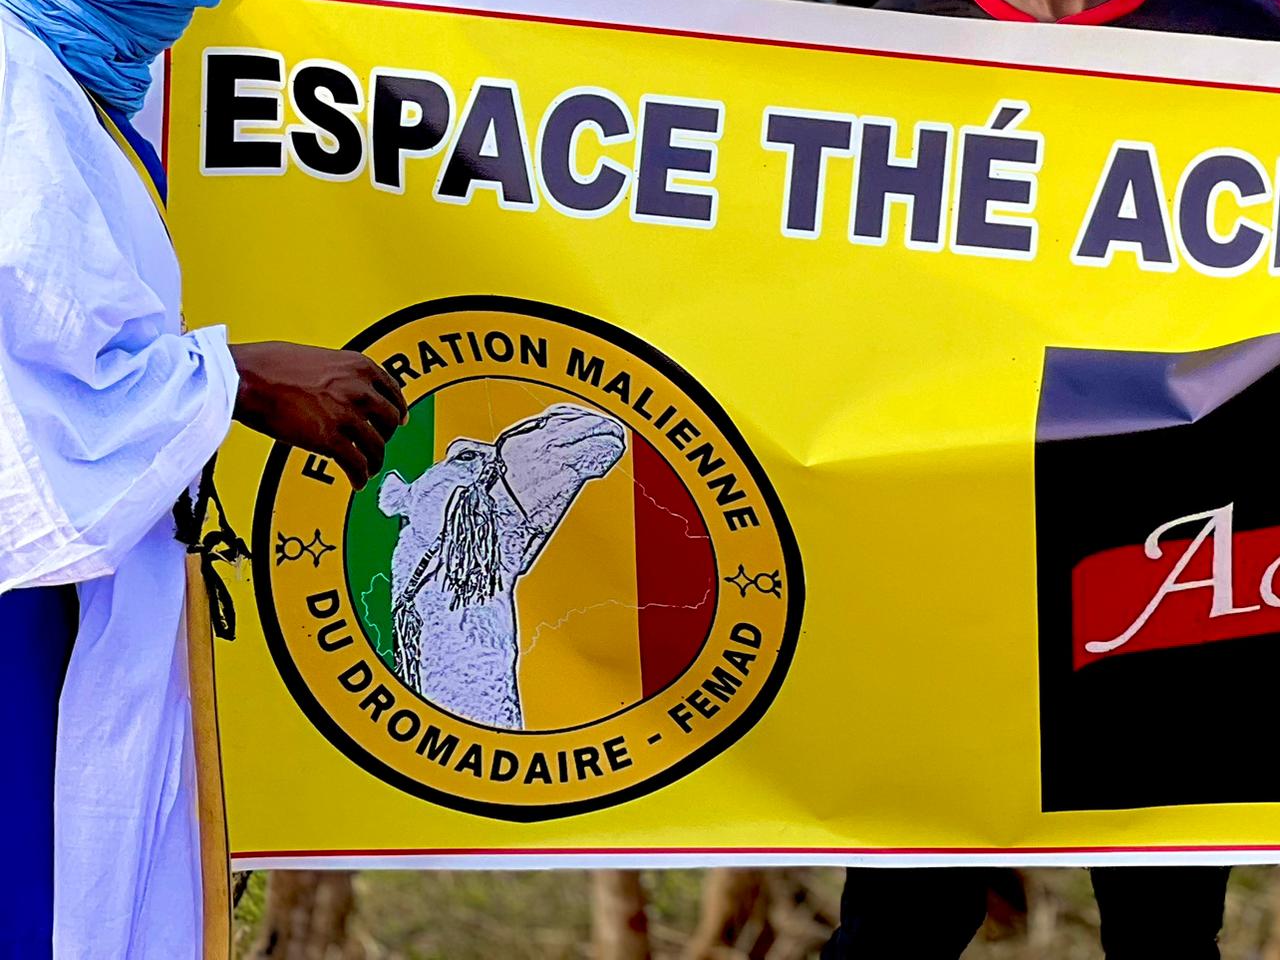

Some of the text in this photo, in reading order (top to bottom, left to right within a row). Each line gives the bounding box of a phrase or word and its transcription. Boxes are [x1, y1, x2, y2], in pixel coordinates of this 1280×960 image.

[202, 49, 724, 228] ESPACE
[763, 100, 1043, 259] THÉ
[301, 330, 761, 532] FRATION MALIENNE
[305, 588, 354, 653] DU
[337, 658, 634, 785] DROMADAIRE
[667, 621, 763, 734] FEMAD
